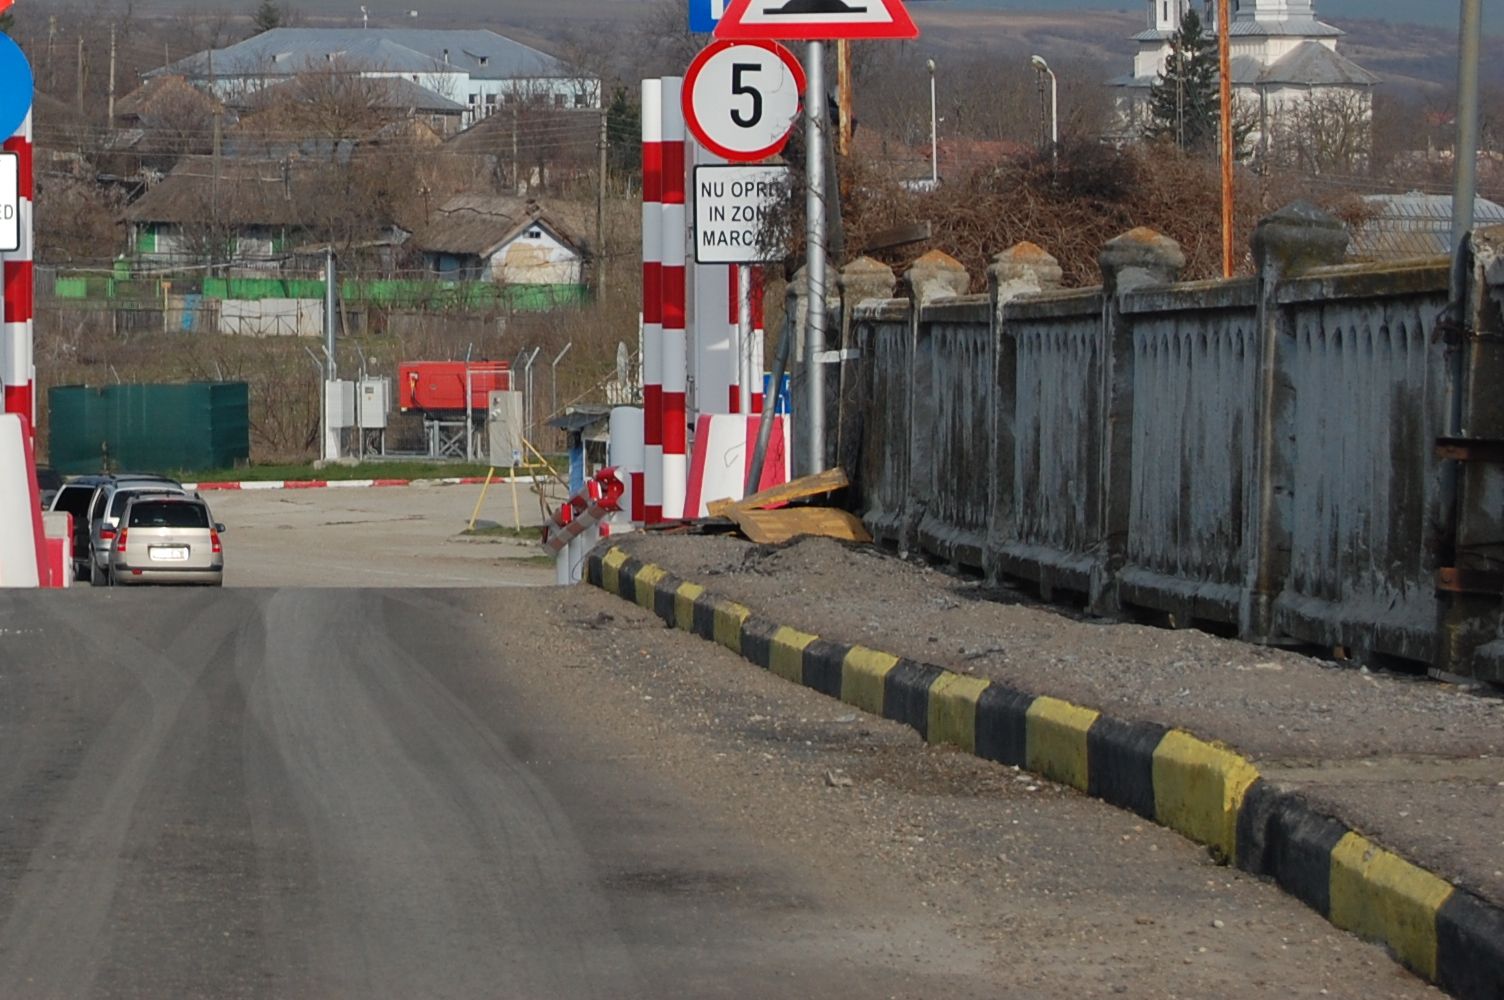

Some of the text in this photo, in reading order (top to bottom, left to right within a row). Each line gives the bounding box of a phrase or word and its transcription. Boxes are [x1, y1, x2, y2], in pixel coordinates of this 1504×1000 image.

[730, 63, 763, 128] 5
[701, 181, 724, 198] NU
[709, 205, 767, 222] IN ZON
[703, 230, 765, 247] MARCA
